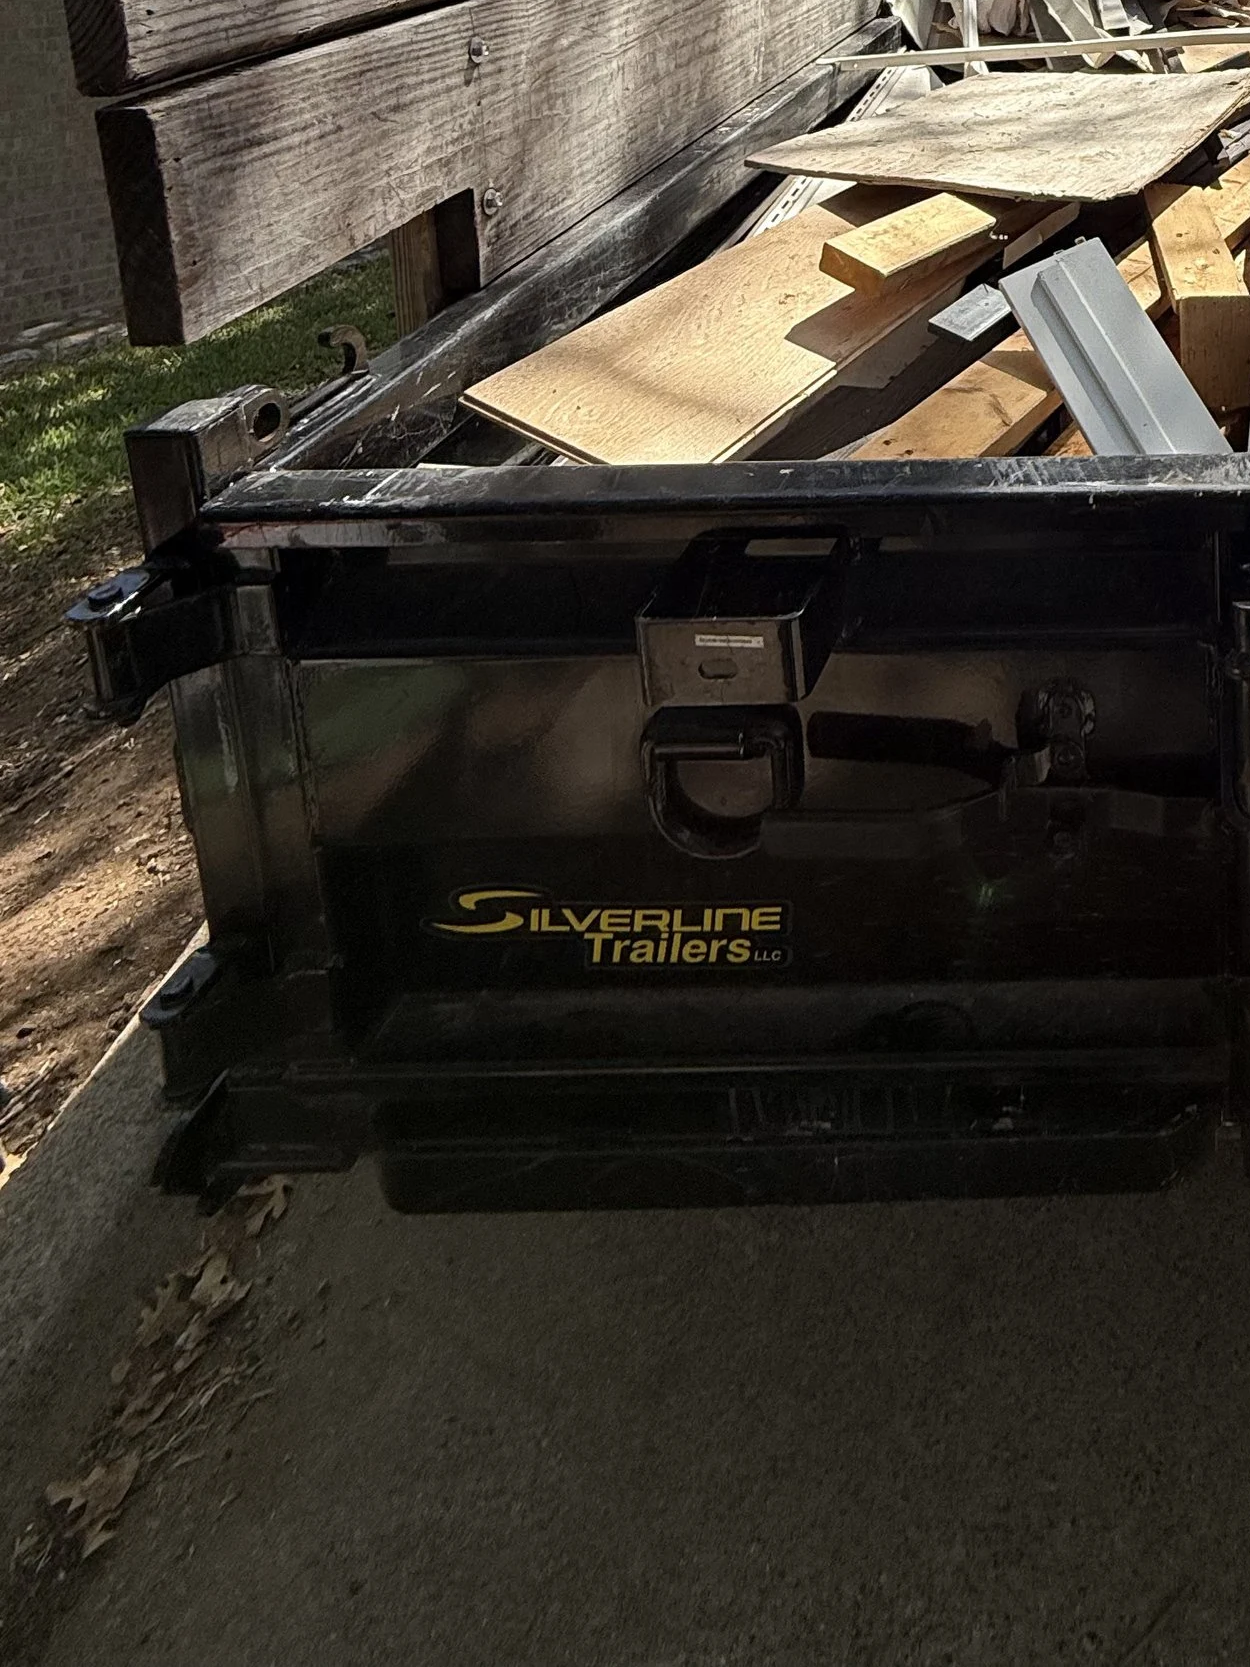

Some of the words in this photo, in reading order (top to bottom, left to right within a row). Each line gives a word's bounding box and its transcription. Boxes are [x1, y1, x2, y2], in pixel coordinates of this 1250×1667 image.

[431, 890, 782, 933] SILVERLINE
[584, 933, 751, 963] Trailers
[754, 951, 782, 962] LLC
